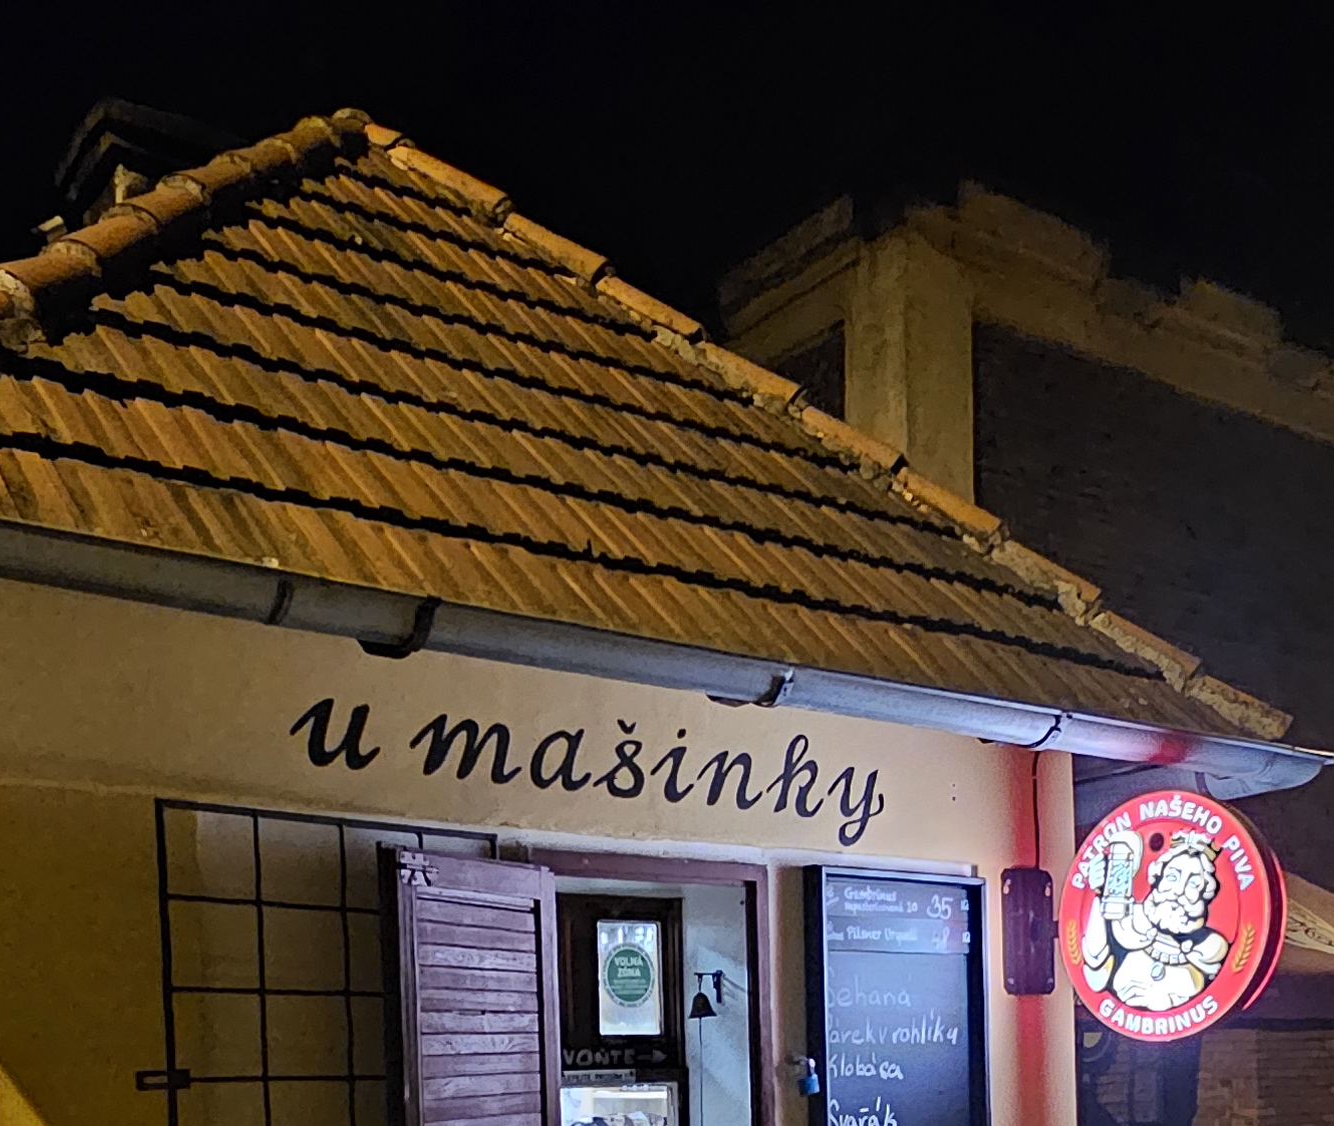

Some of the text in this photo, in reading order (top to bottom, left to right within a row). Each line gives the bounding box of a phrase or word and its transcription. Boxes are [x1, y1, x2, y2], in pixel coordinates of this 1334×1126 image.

[290, 697, 885, 847] u mašinky
[1071, 795, 1256, 891] PATRON NAŠEHO PIVA
[926, 894, 954, 920] 35
[1098, 995, 1219, 1036] GAMBRINUS
